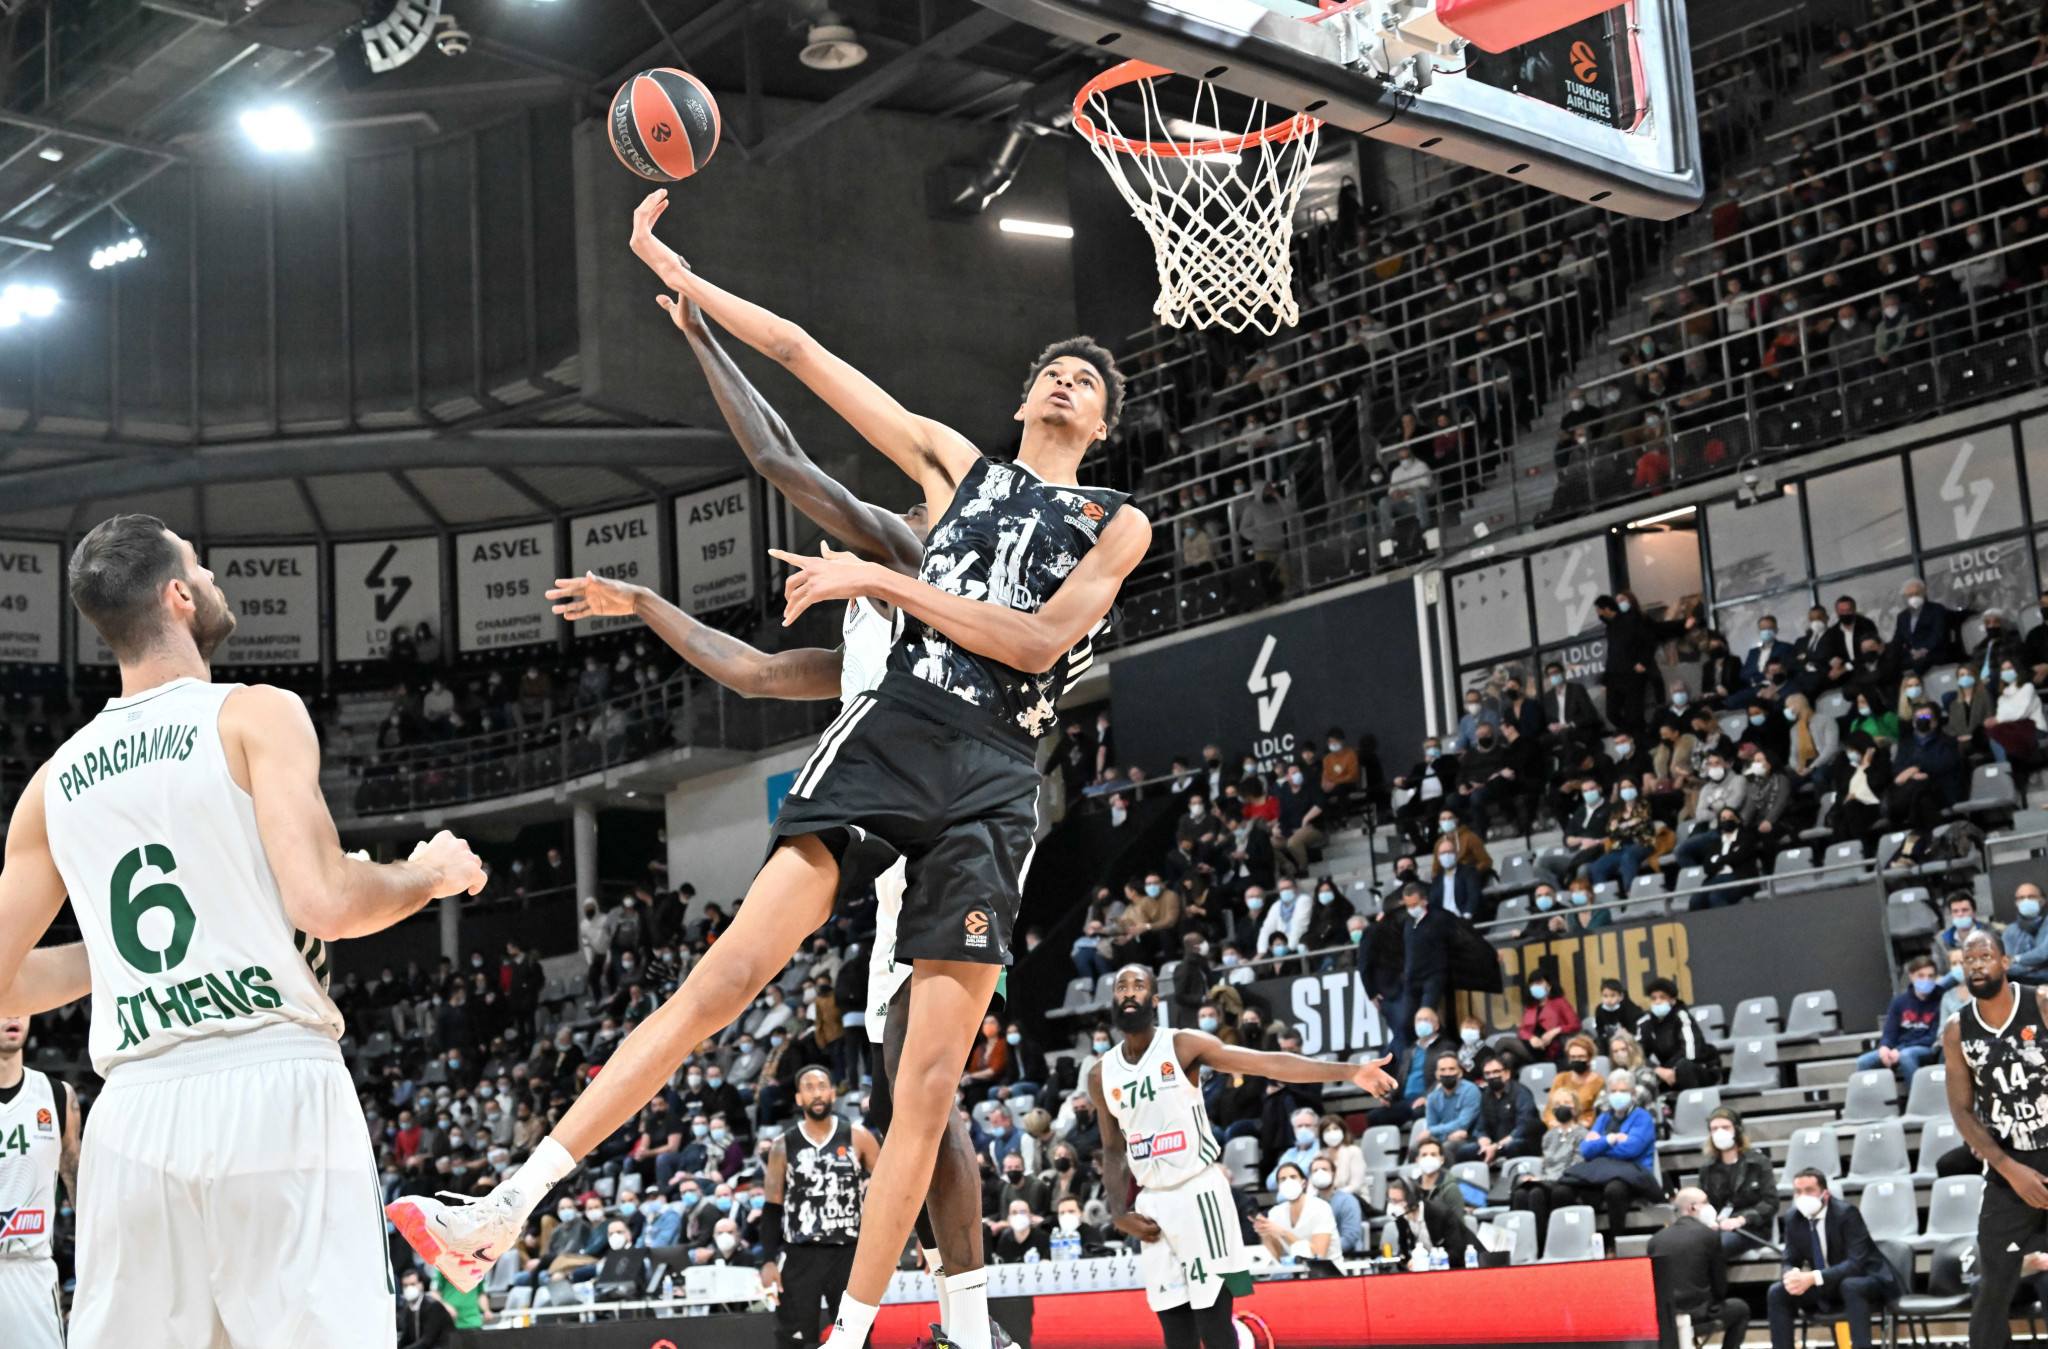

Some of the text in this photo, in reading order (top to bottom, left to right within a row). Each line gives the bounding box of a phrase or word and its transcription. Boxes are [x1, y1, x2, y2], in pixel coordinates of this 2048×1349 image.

[1565, 79, 1609, 105] TURKISH
[1567, 94, 1611, 118] AIRLINES
[689, 493, 744, 525] ASVEL
[586, 518, 648, 546] ASVEL
[472, 537, 541, 563] ASVEL
[701, 538, 736, 561] 1957
[1950, 545, 2000, 573] LDLC
[226, 559, 301, 577] ASVEL
[1952, 567, 2002, 590] ASVEL
[485, 579, 530, 600] 1955
[693, 573, 746, 594] CHAMPION
[240, 600, 287, 616] 1952
[475, 613, 542, 631] CHAMPION
[227, 635, 300, 647] CHAMPION
[477, 628, 541, 646] DE FRANCE
[228, 650, 299, 661] DE FRANCE
[1562, 641, 1603, 665] LDLC
[1253, 733, 1295, 758] LDLC
[59, 724, 198, 802] PAPAGIANNIS
[110, 843, 197, 974] 6
[115, 965, 284, 1051] ATHENS
[1992, 1062, 2029, 1094] 14
[1122, 1075, 1156, 1109] 74
[811, 1172, 838, 1197] 23
[820, 1204, 855, 1219] LDLC
